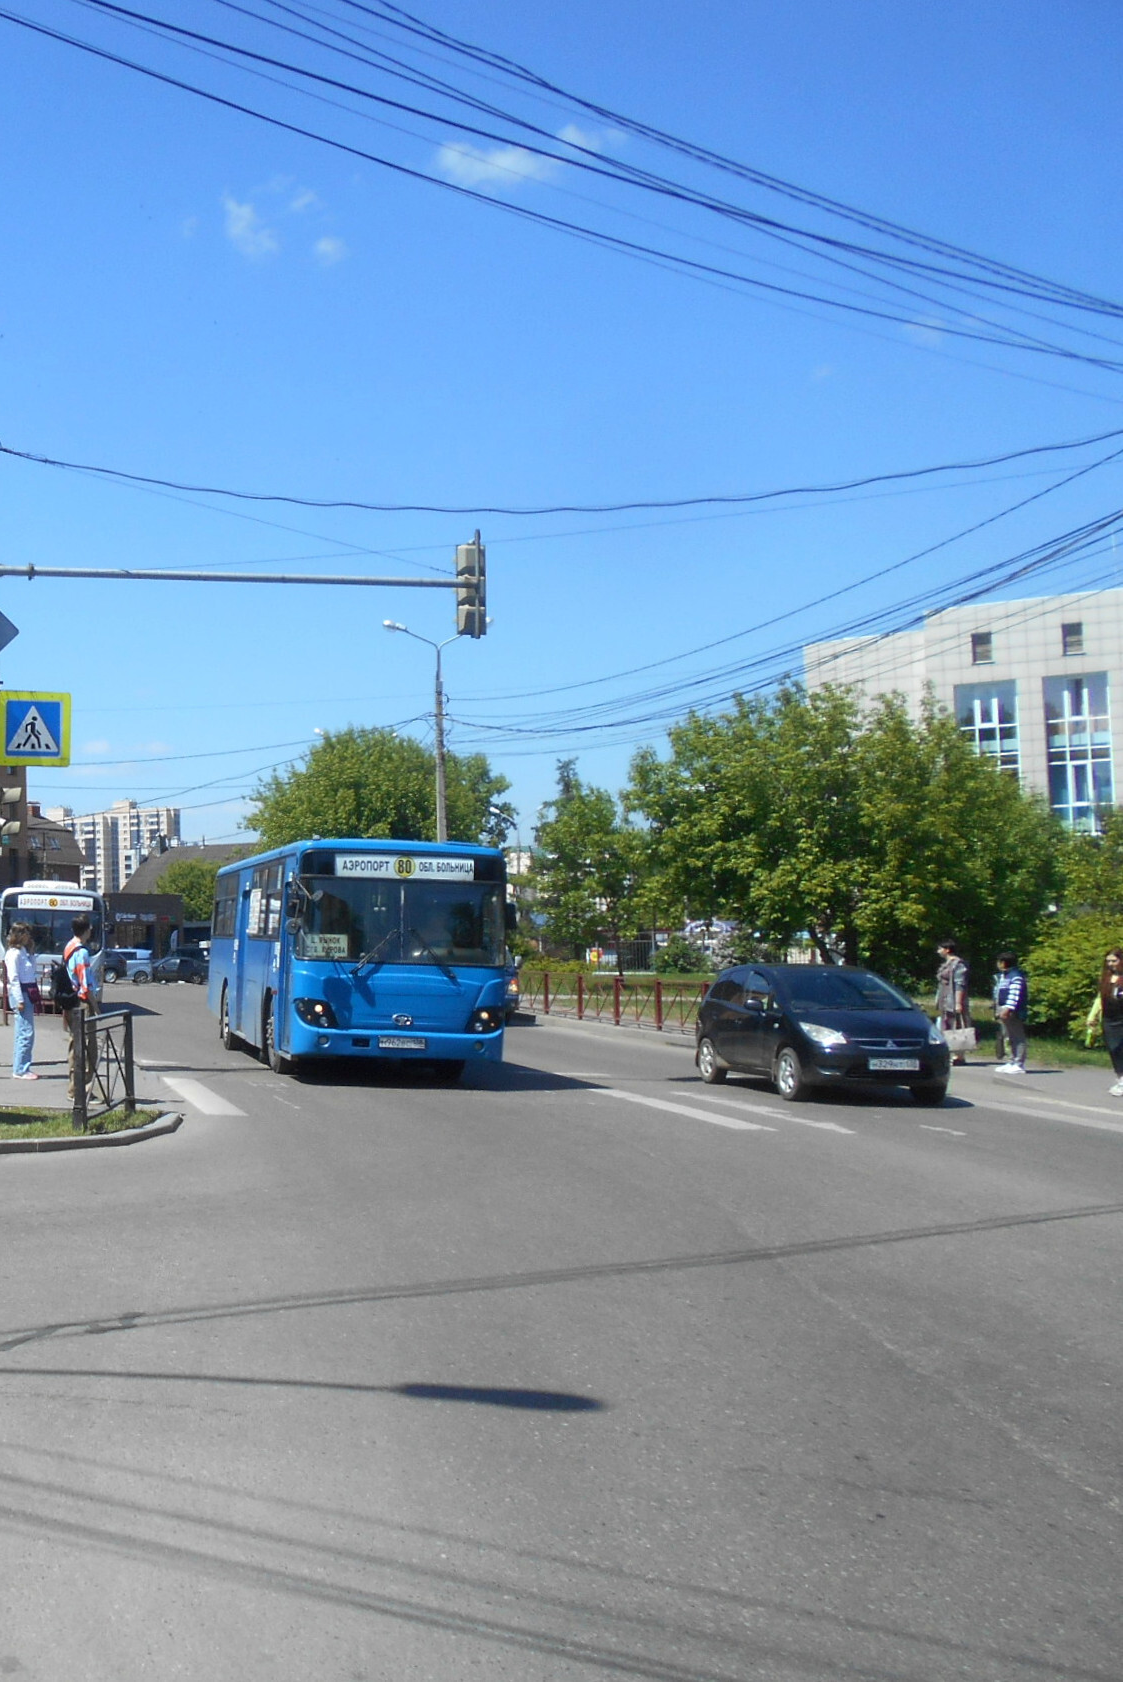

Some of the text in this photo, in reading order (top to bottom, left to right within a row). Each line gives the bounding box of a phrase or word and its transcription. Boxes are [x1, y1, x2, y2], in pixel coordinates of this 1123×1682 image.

[342, 859, 474, 875] АЭРОПОРТ 80 ОБЛ. БОЛЬНИЦА
